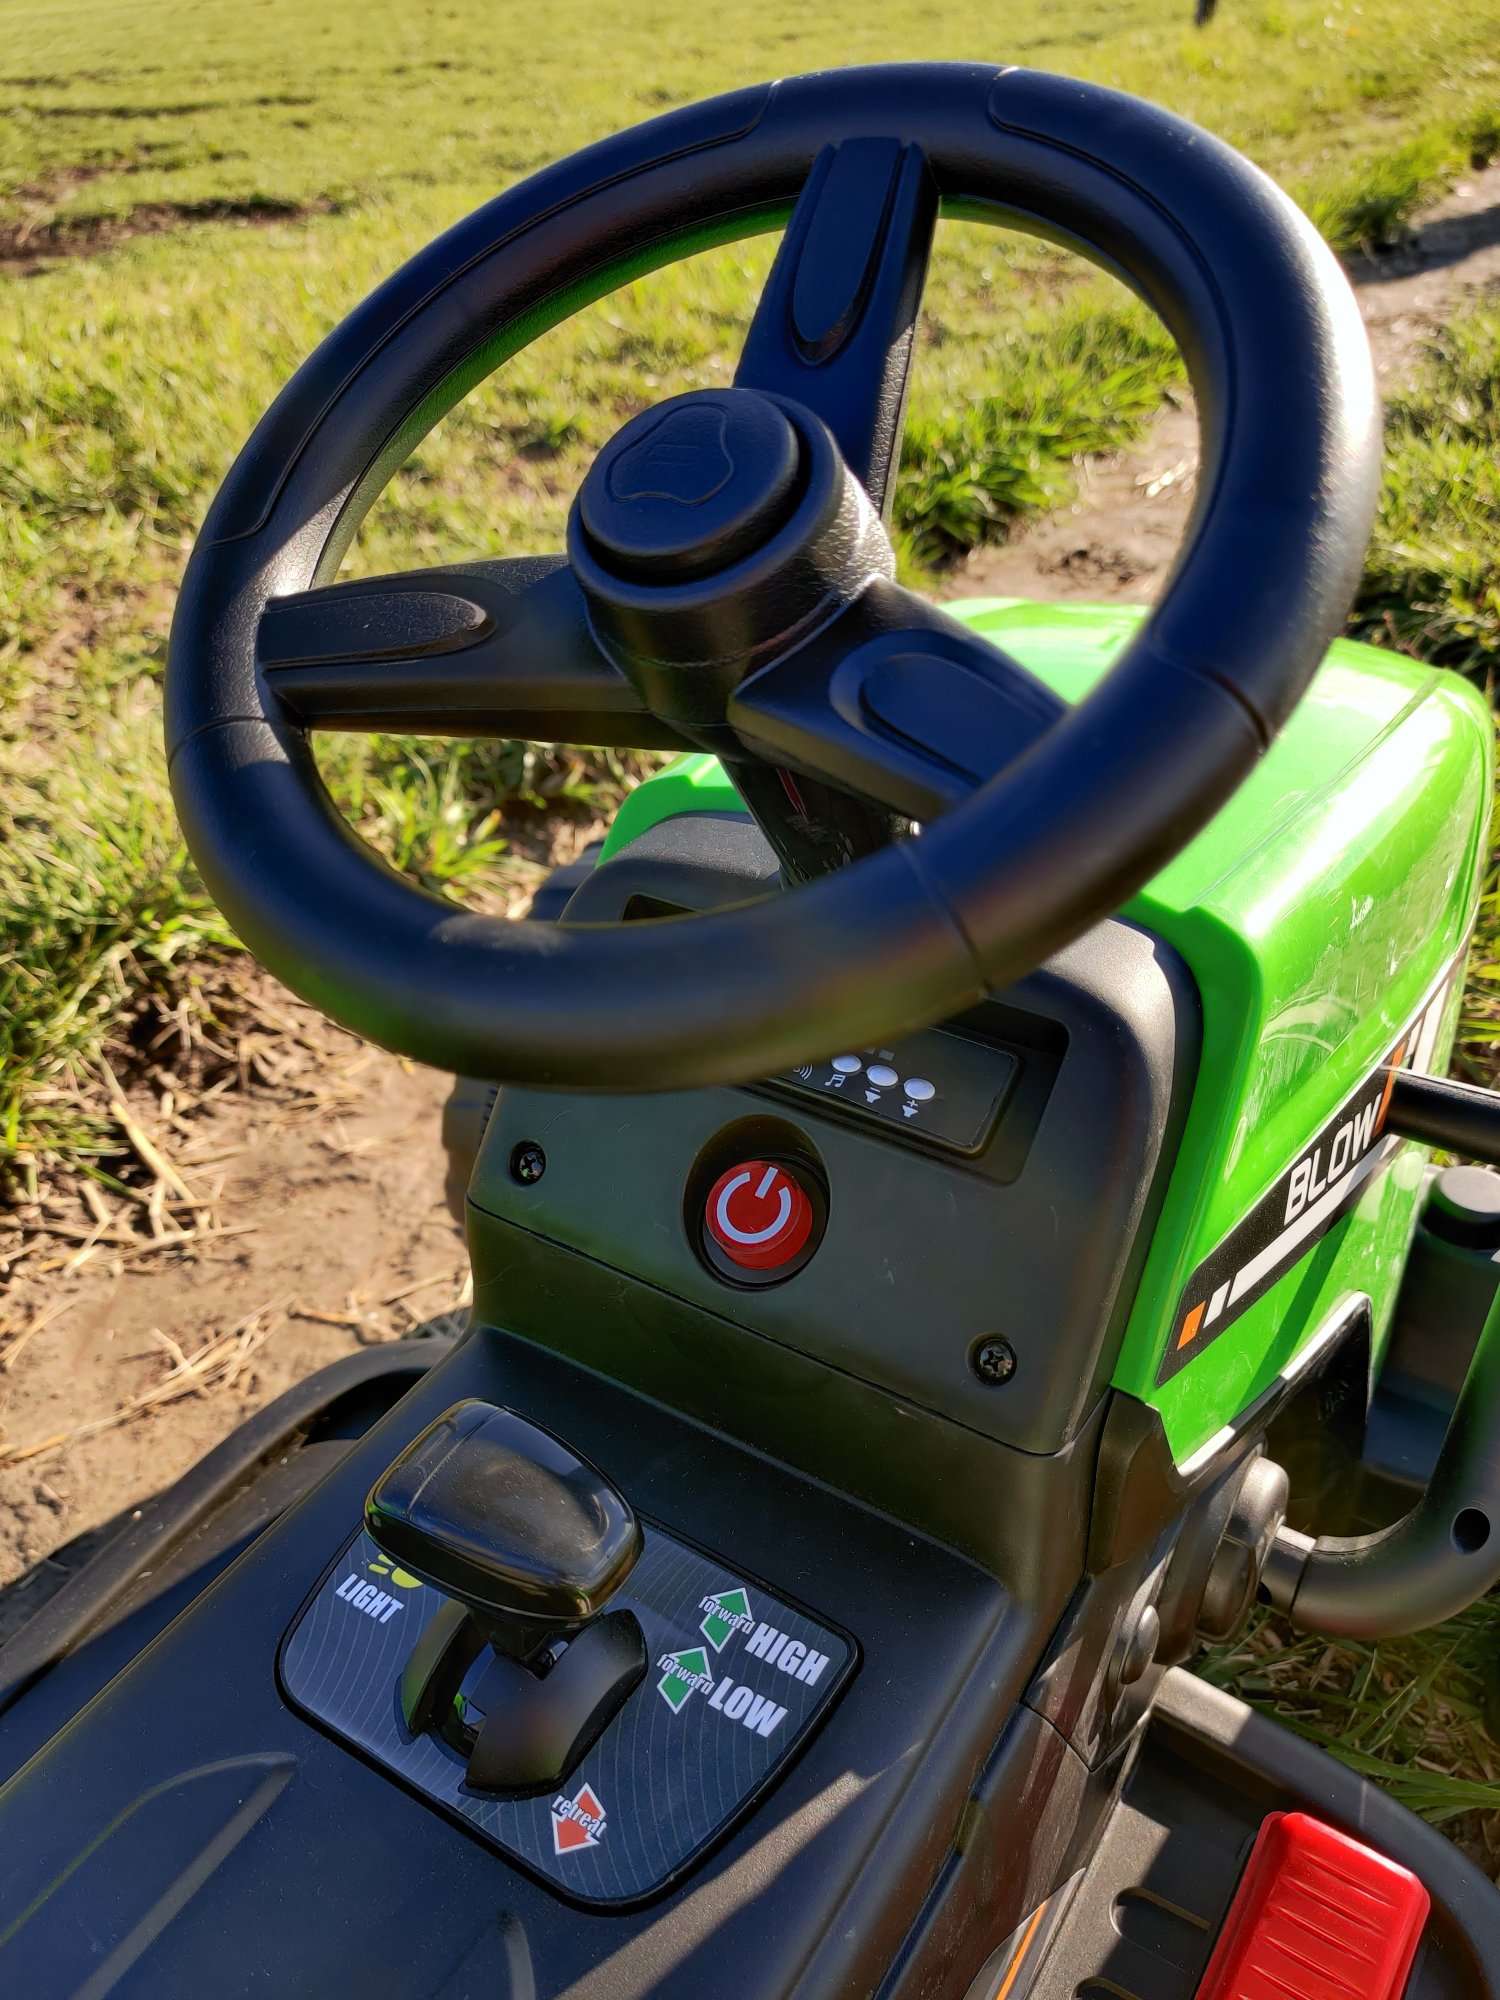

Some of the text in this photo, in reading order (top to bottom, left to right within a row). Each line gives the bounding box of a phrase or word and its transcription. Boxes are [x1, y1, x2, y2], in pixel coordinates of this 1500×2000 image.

[1283, 1092, 1382, 1226] BLOW
[336, 1573, 405, 1624] LIGHT
[699, 1596, 830, 1686] forward HIGH
[656, 1653, 788, 1738] forward LOW
[552, 1795, 607, 1838] retreat
